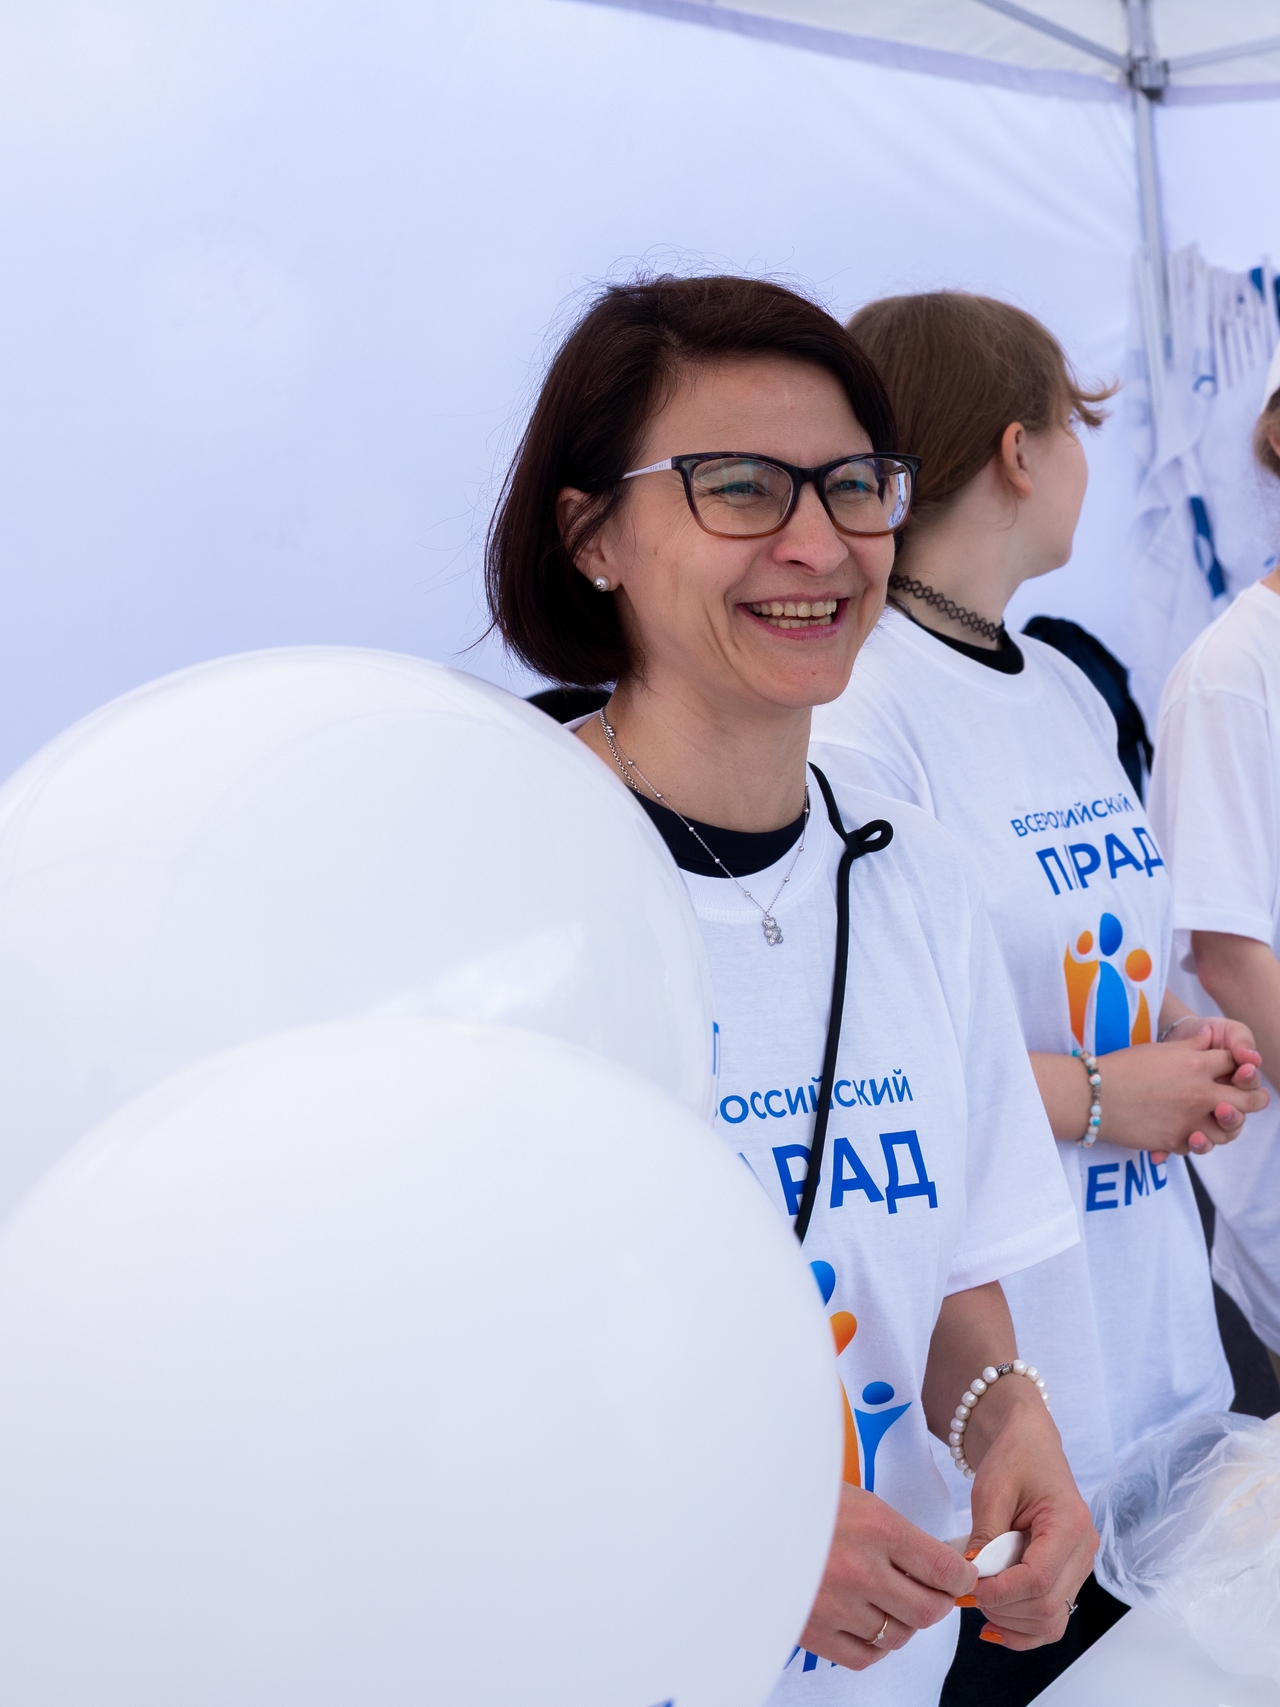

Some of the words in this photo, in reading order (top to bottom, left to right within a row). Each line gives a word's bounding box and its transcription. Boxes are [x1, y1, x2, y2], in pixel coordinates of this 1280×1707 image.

[1036, 827, 1169, 896] ПРАД
[718, 1068, 914, 1124] ОССИЙСКИЙ
[768, 1129, 939, 1216] РАД
